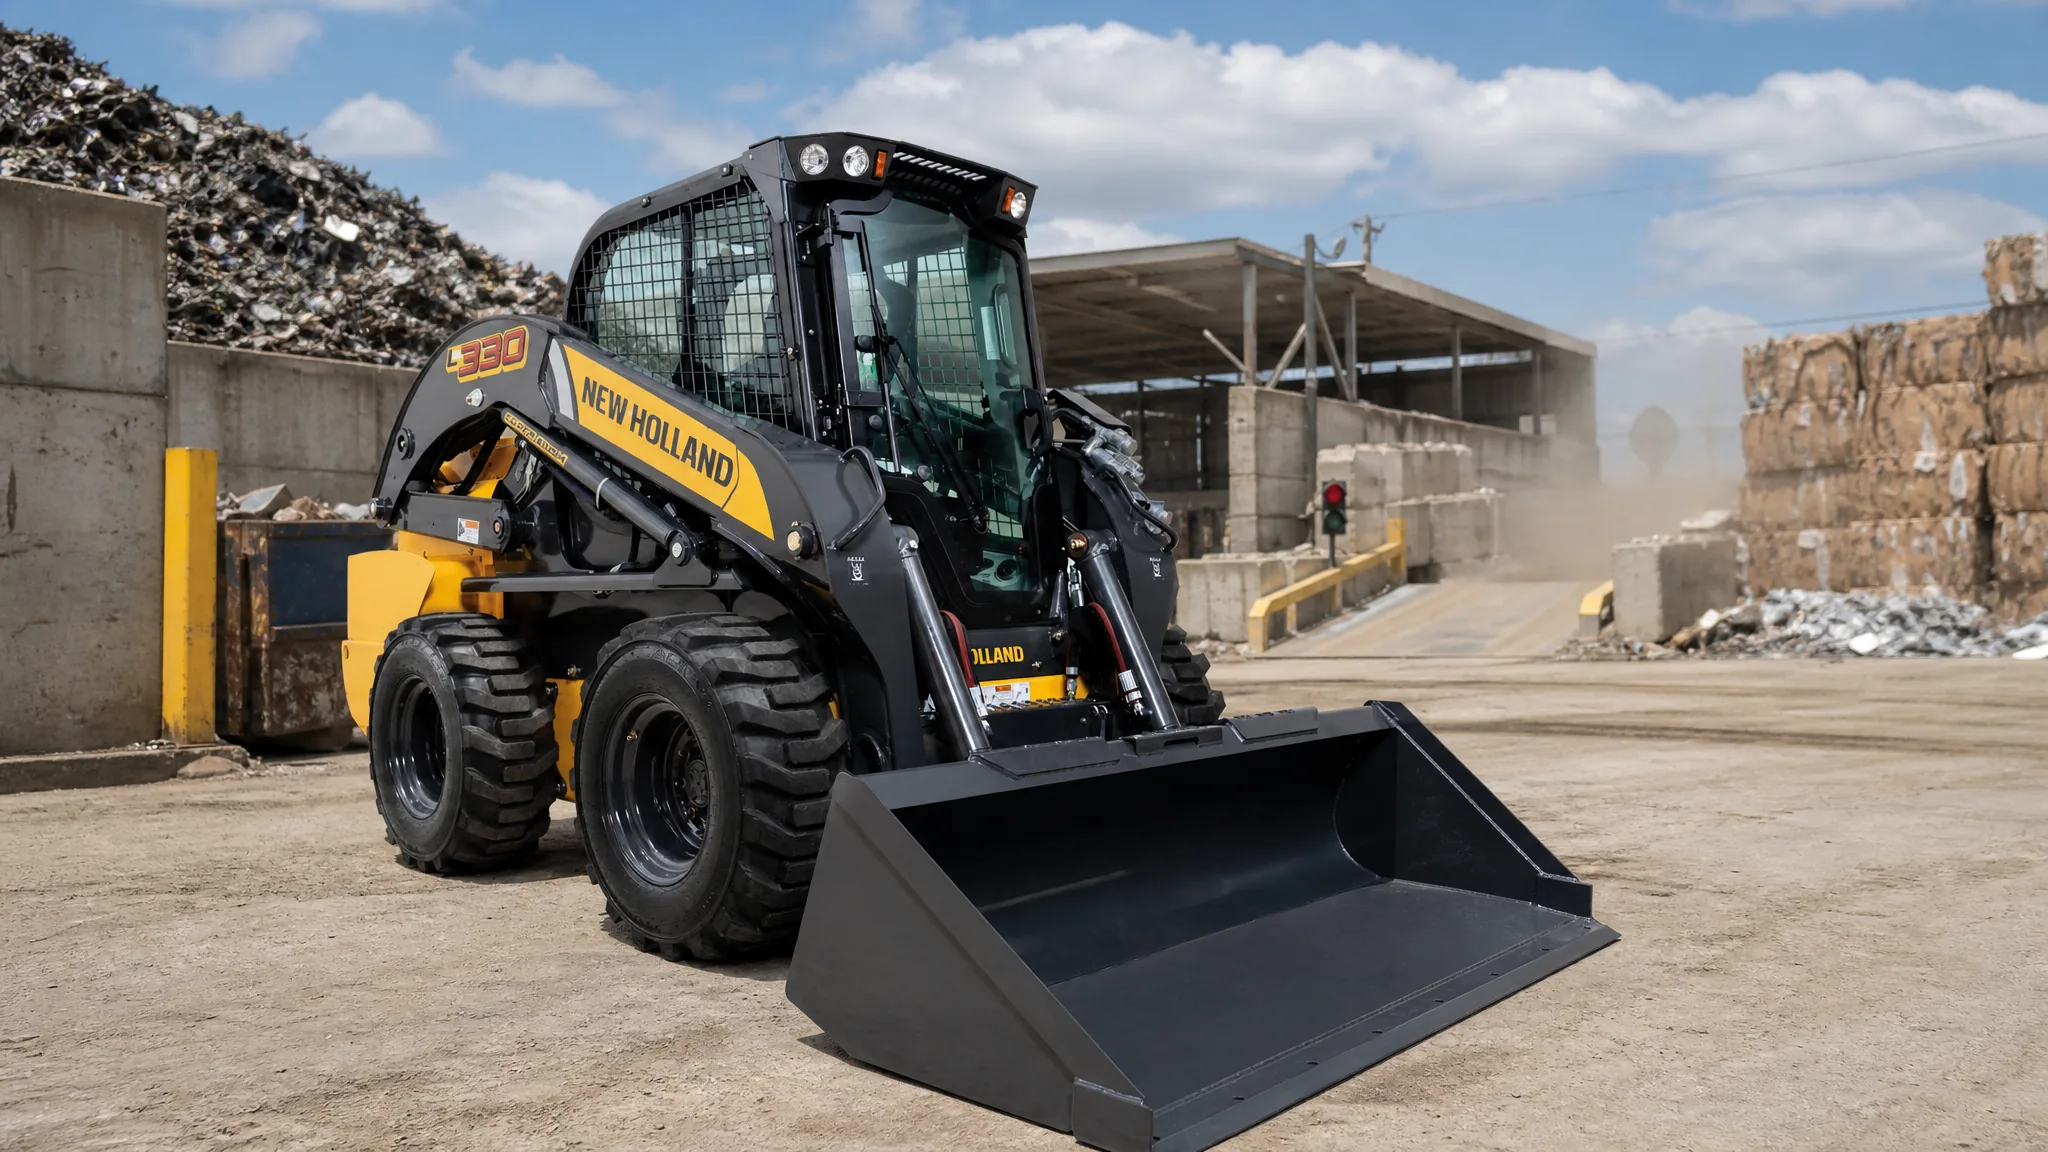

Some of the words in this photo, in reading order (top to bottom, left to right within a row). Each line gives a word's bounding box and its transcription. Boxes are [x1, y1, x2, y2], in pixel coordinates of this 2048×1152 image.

[446, 326, 528, 382] L330
[581, 376, 628, 425] NEW
[629, 403, 733, 487] HOLLAND
